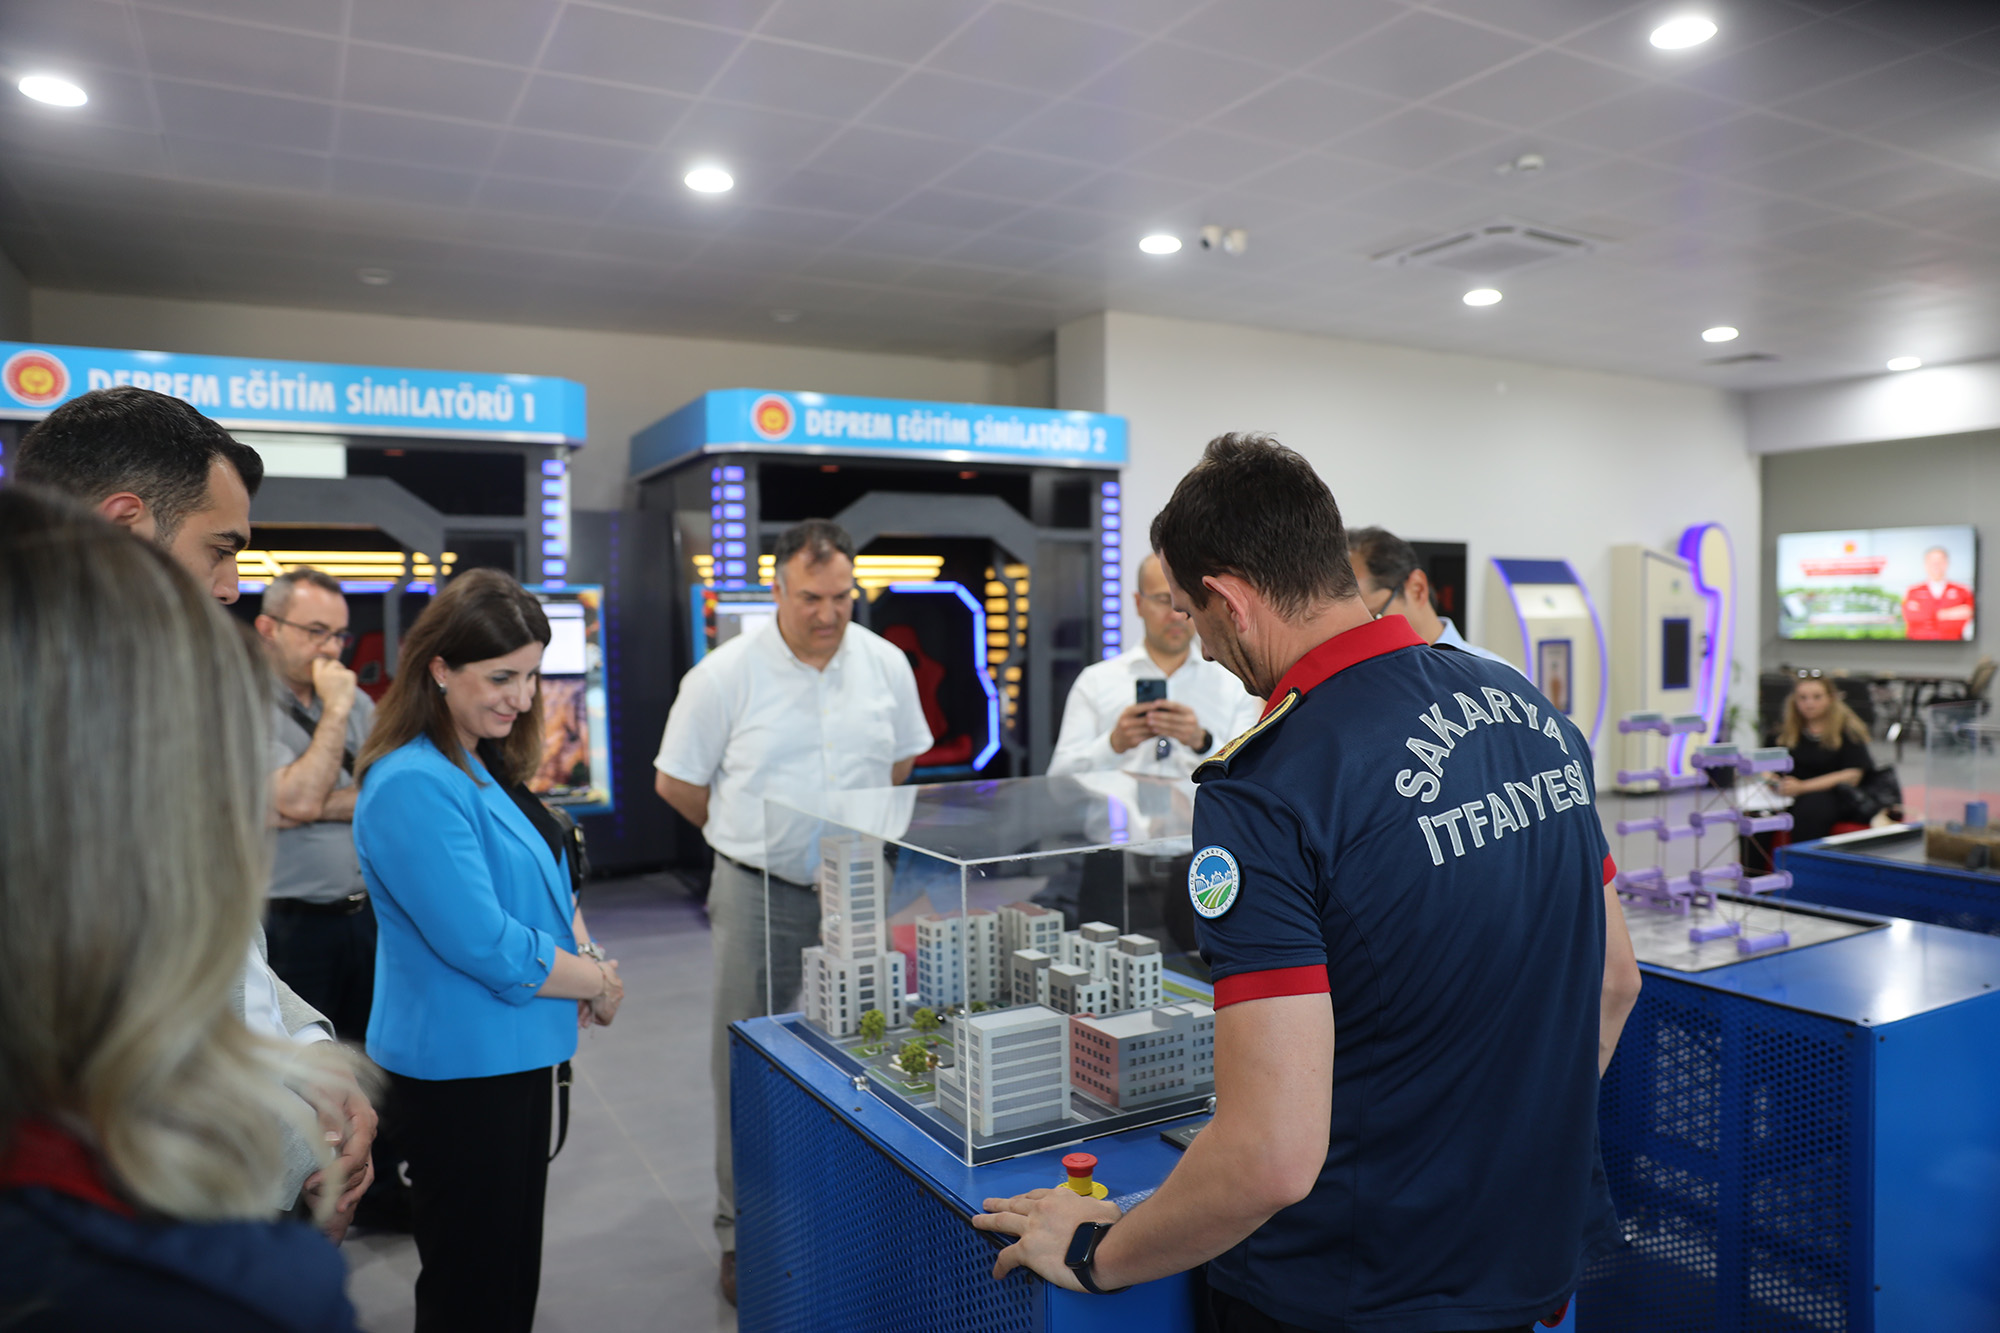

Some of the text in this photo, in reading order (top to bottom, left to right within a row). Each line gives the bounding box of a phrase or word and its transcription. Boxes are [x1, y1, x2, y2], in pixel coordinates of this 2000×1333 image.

[87, 367, 536, 423] DEPREM EĞİTİM SİMİLATÖRÜ 1
[805, 408, 894, 440] DEPREM
[897, 409, 971, 445] EĞİTİM
[1092, 427, 1107, 454] 2
[1395, 686, 1569, 803] SAKARYA
[1417, 760, 1590, 866] İTFAİYESİ
